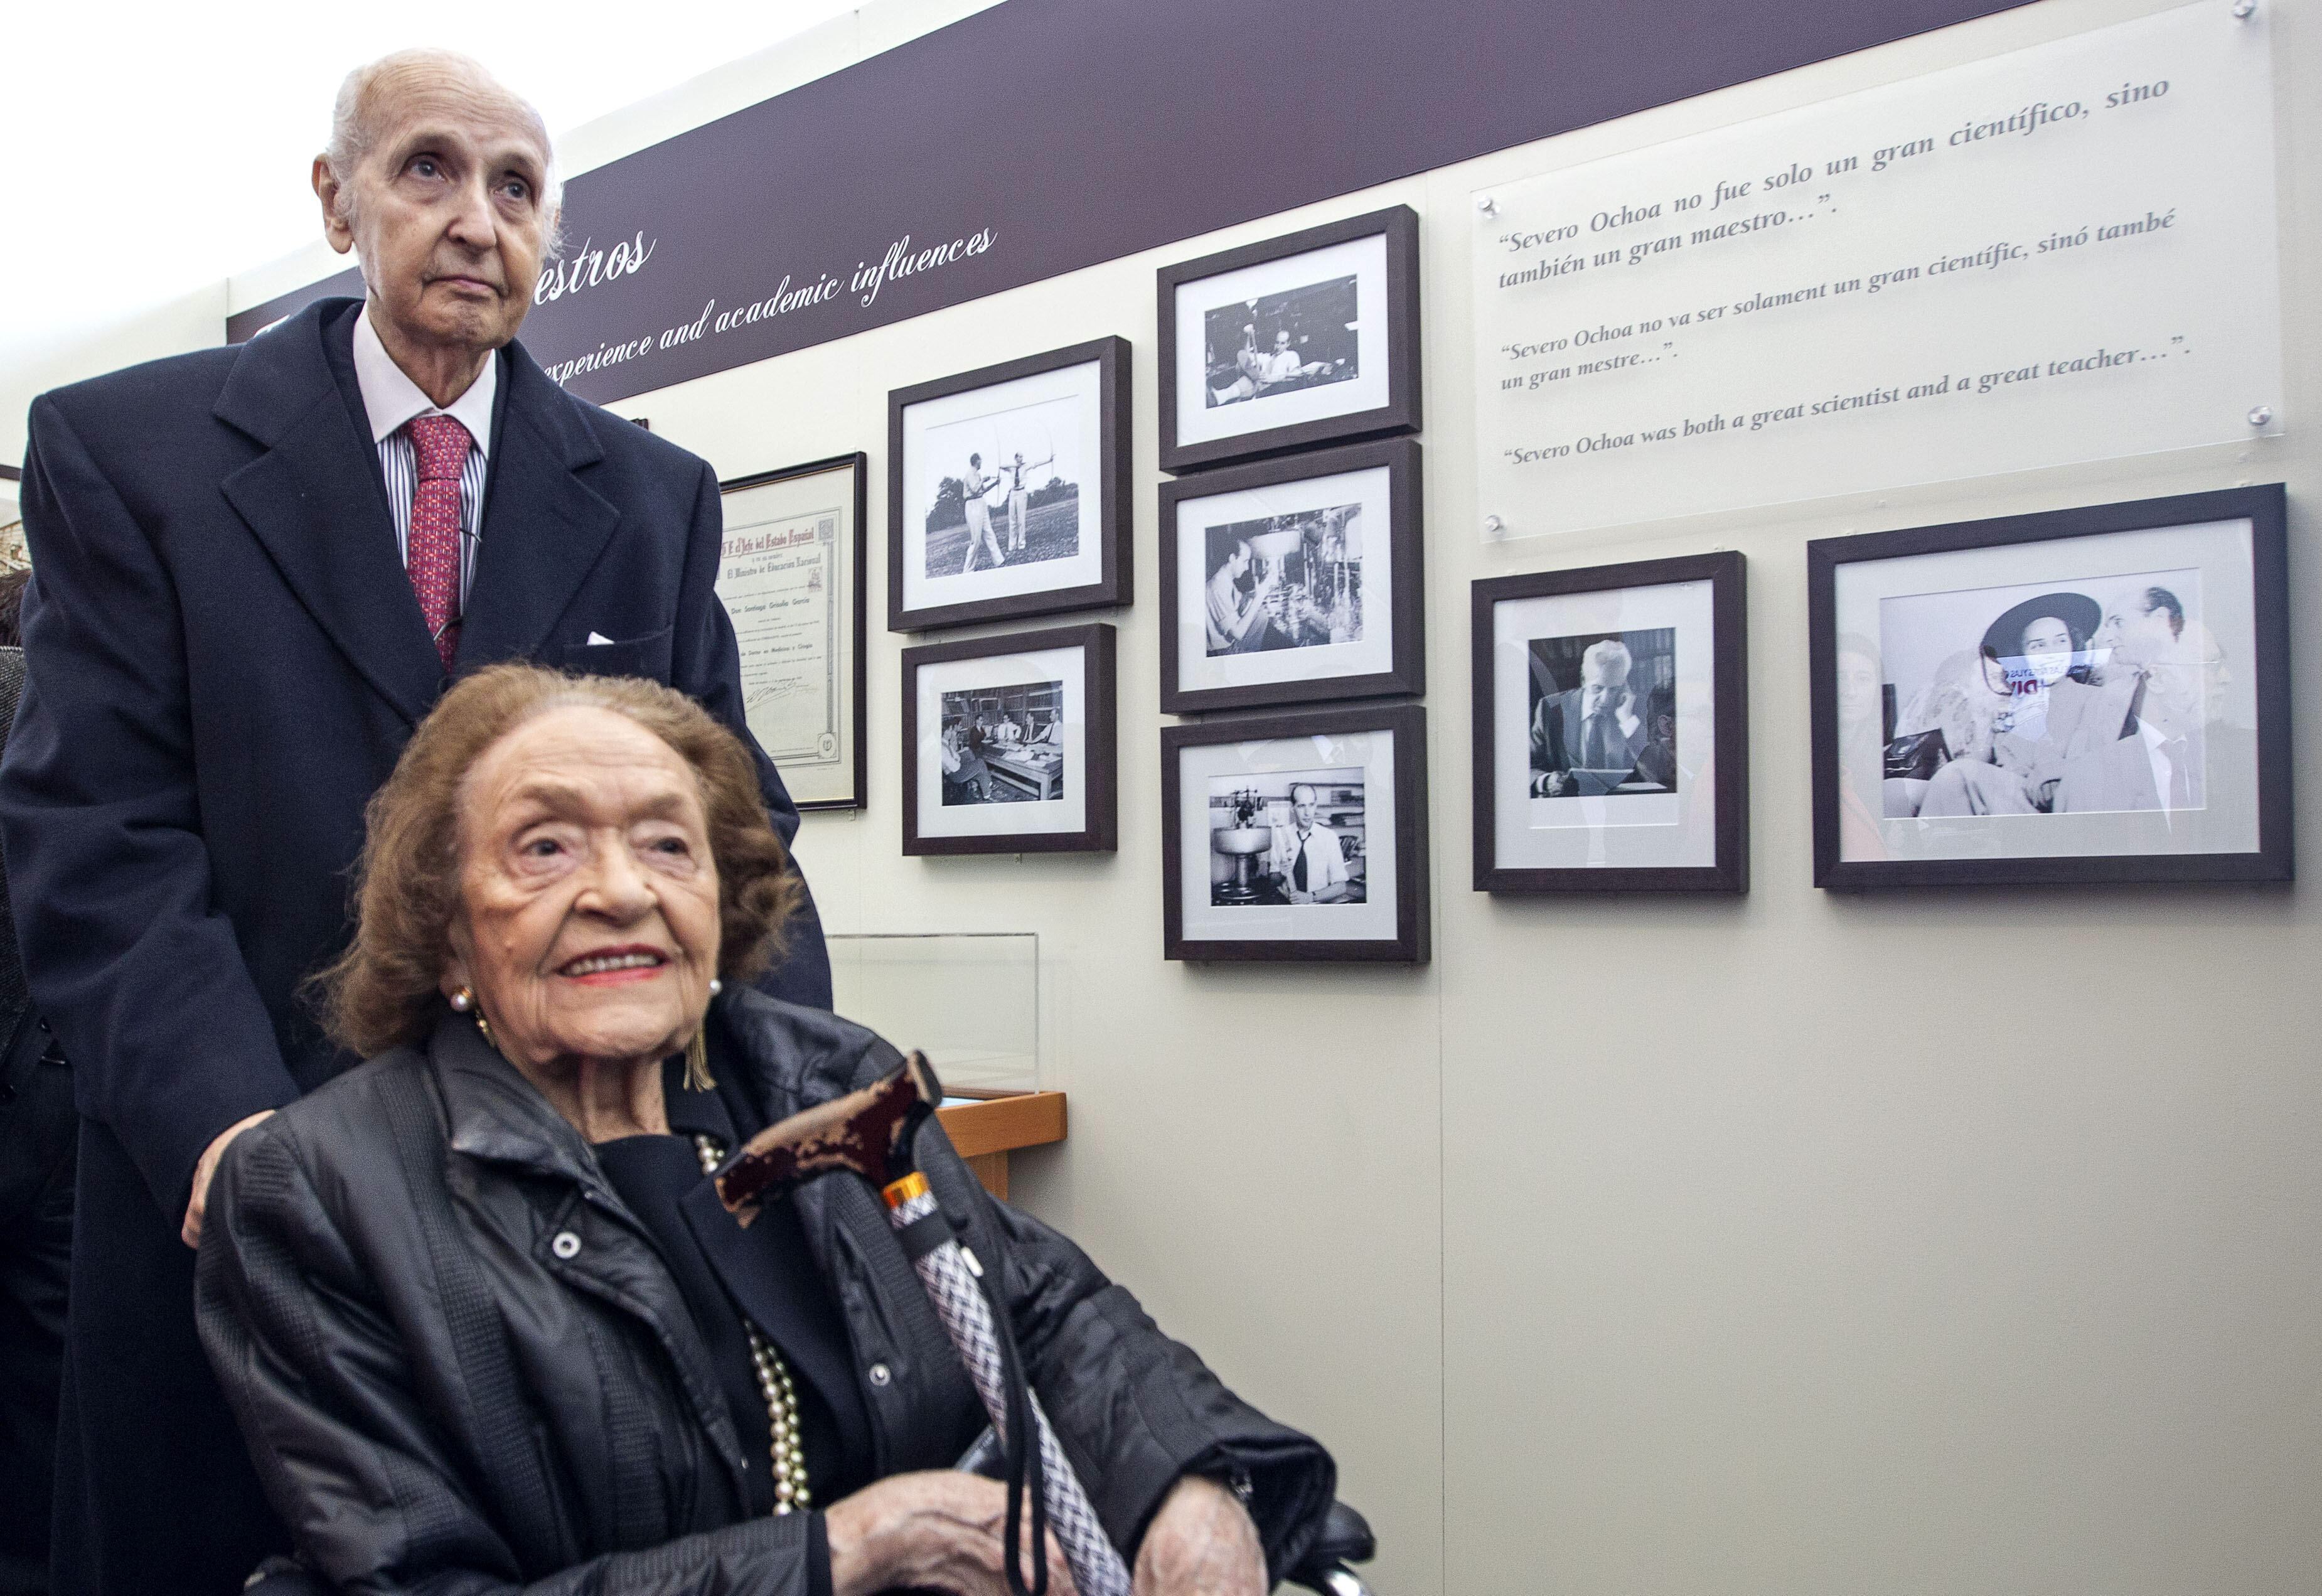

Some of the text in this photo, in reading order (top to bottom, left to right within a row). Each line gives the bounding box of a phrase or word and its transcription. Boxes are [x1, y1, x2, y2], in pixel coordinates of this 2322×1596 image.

[1590, 203, 1661, 232] Ochoa
[1674, 193, 1702, 213] no
[1711, 182, 1751, 210] fue
[1763, 163, 1812, 191] solo
[1826, 155, 1858, 176] un
[1871, 137, 1934, 172] gran
[1949, 102, 2089, 146] científico,
[2105, 80, 2170, 108] sino
[534, 230, 656, 306] estros
[544, 227, 997, 387] experience and academic influences
[1499, 254, 1585, 289] también
[1593, 249, 1622, 266] un
[1629, 235, 1682, 265] gran
[1574, 324, 1632, 348] Ochoa
[1639, 320, 1662, 335] no
[1669, 313, 1691, 328] va
[1697, 304, 1728, 323] ser
[1733, 283, 1827, 316] solament
[1834, 279, 1861, 296] un
[1868, 265, 1920, 293] gran
[1928, 242, 2029, 277] científic,
[2036, 227, 2088, 254] sinó
[2097, 208, 2176, 242] també
[1501, 376, 1523, 390] un
[1529, 366, 1570, 390] gran
[1576, 432, 1634, 454] Ochoa
[1641, 427, 1676, 443] was
[1683, 414, 1725, 437] both
[1732, 415, 1744, 428] a
[1751, 402, 1804, 431] great
[1811, 386, 1900, 416] scientist
[1907, 375, 1949, 400] and
[1957, 377, 1971, 390] a
[1978, 362, 2040, 394] great
